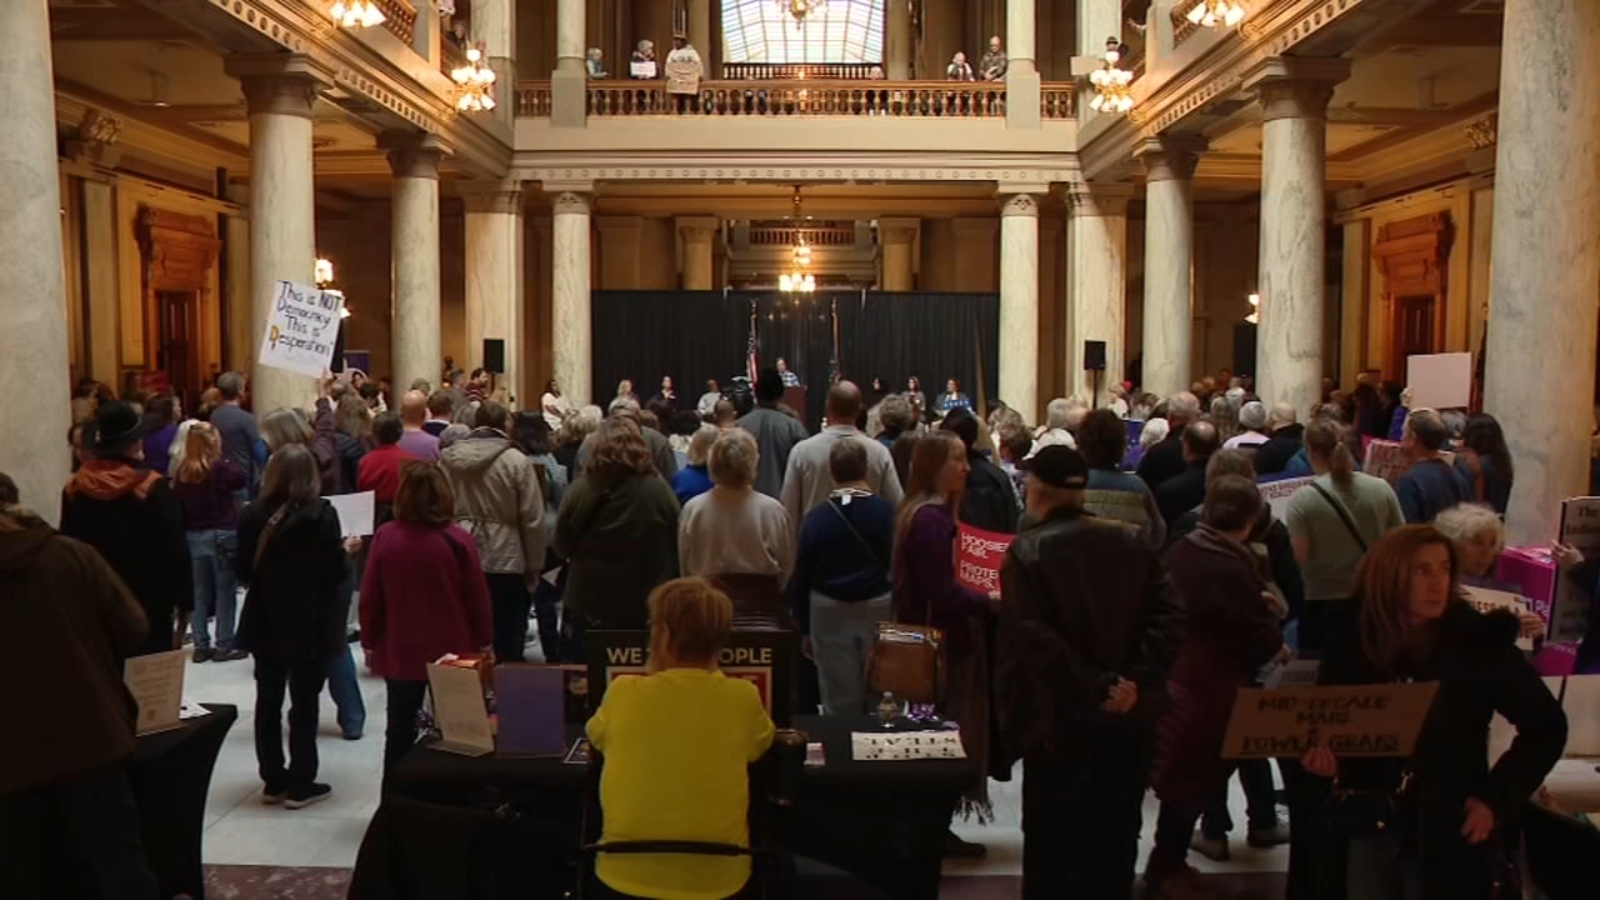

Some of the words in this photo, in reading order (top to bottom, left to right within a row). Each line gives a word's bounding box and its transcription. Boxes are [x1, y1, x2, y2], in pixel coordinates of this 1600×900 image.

[277, 280, 303, 302] This
[307, 294, 316, 305] is
[318, 292, 342, 312] NOT
[276, 299, 331, 330] Democracy
[284, 314, 307, 333] This
[312, 327, 321, 337] is
[961, 532, 1010, 553] HOOSIE
[960, 560, 999, 580] PROTE
[606, 647, 642, 664] WE
[719, 647, 773, 664] OPLE
[1242, 735, 1319, 752] POWER
[1328, 734, 1400, 752] GRABS
